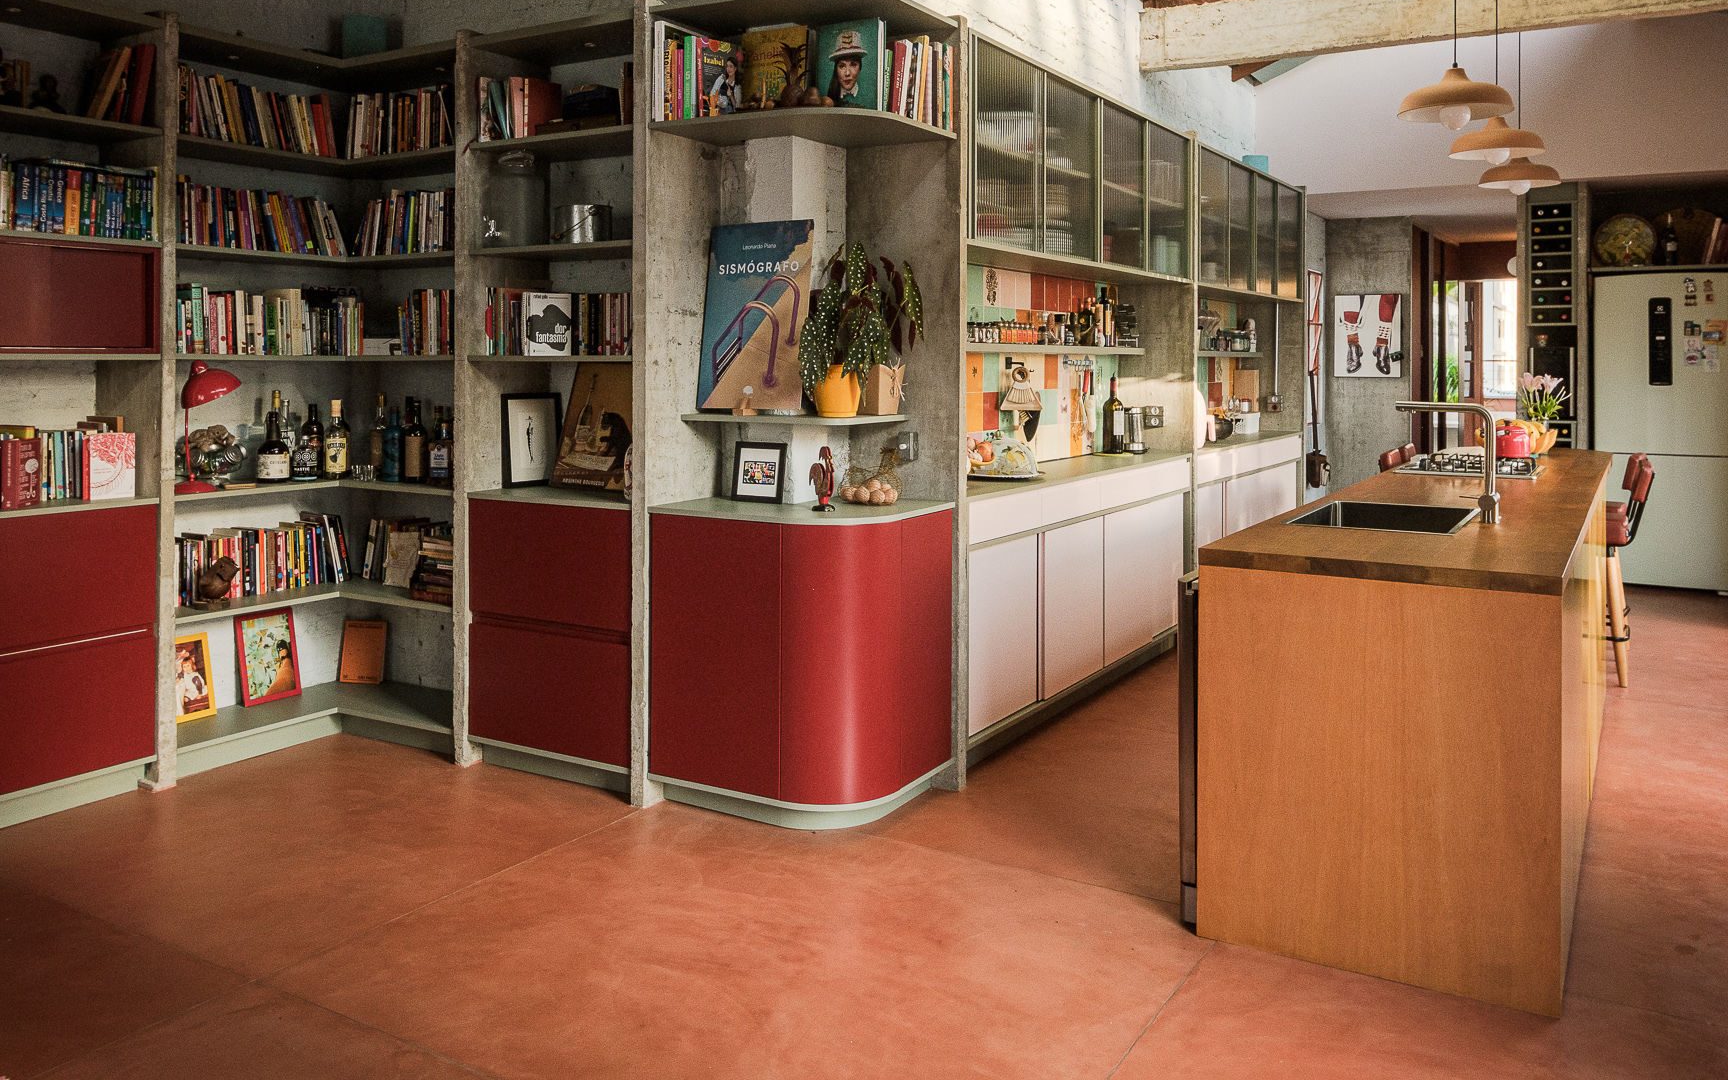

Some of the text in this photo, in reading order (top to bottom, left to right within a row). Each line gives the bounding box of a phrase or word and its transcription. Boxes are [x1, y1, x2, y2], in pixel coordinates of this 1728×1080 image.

[703, 56, 724, 67] Izabel
[685, 71, 690, 80] 5
[22, 177, 31, 200] Africa
[743, 242, 776, 251] Leonardo Piana
[718, 260, 800, 275] SISMÓGRAFO
[554, 322, 567, 334] dor
[535, 331, 567, 343] fantasma
